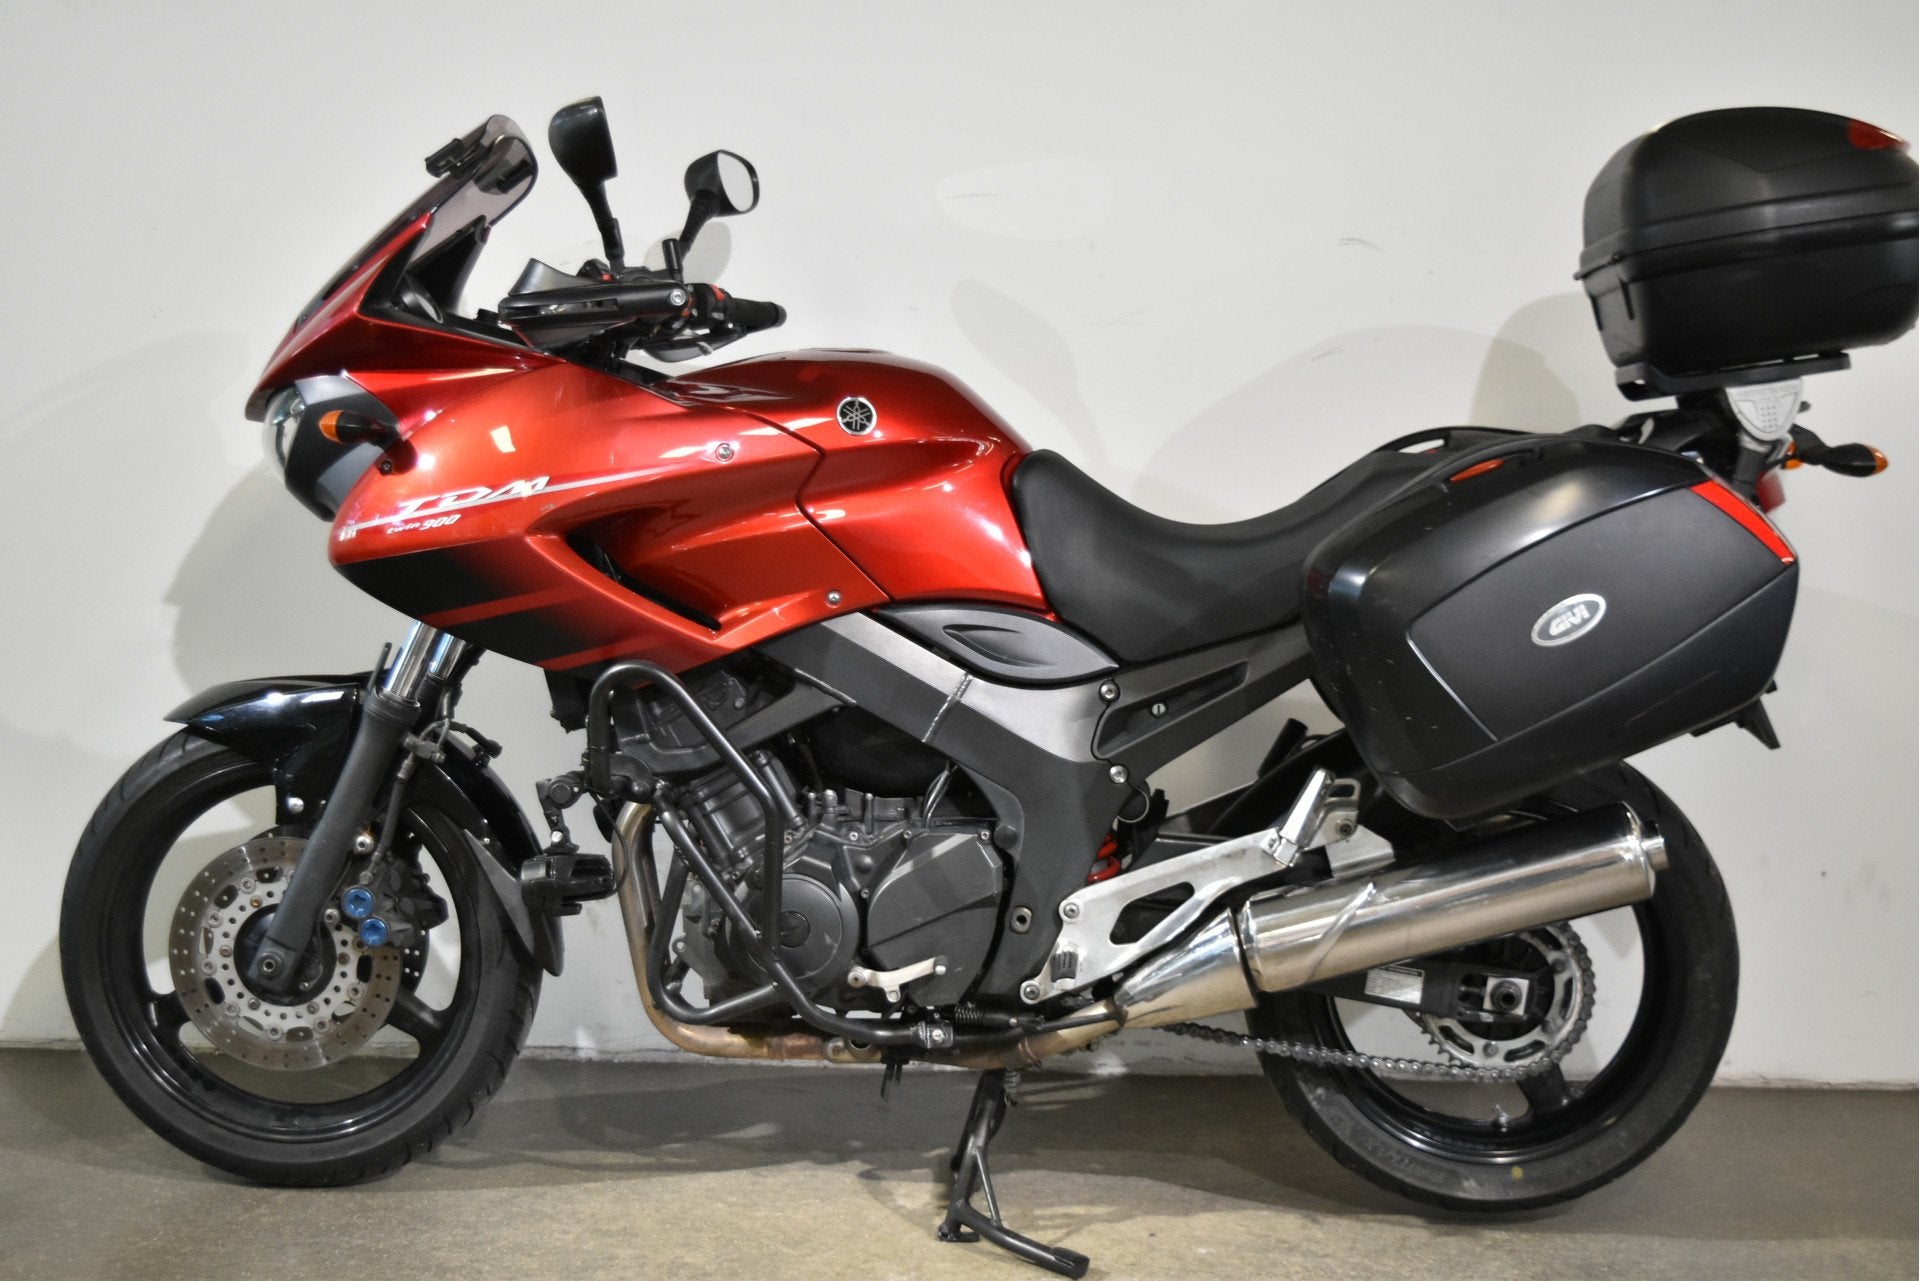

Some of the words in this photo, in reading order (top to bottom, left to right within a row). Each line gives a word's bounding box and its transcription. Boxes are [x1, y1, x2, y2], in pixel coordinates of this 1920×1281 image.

[396, 476, 550, 516] TDM
[419, 514, 462, 531] 900
[1548, 603, 1590, 636] GIVI
